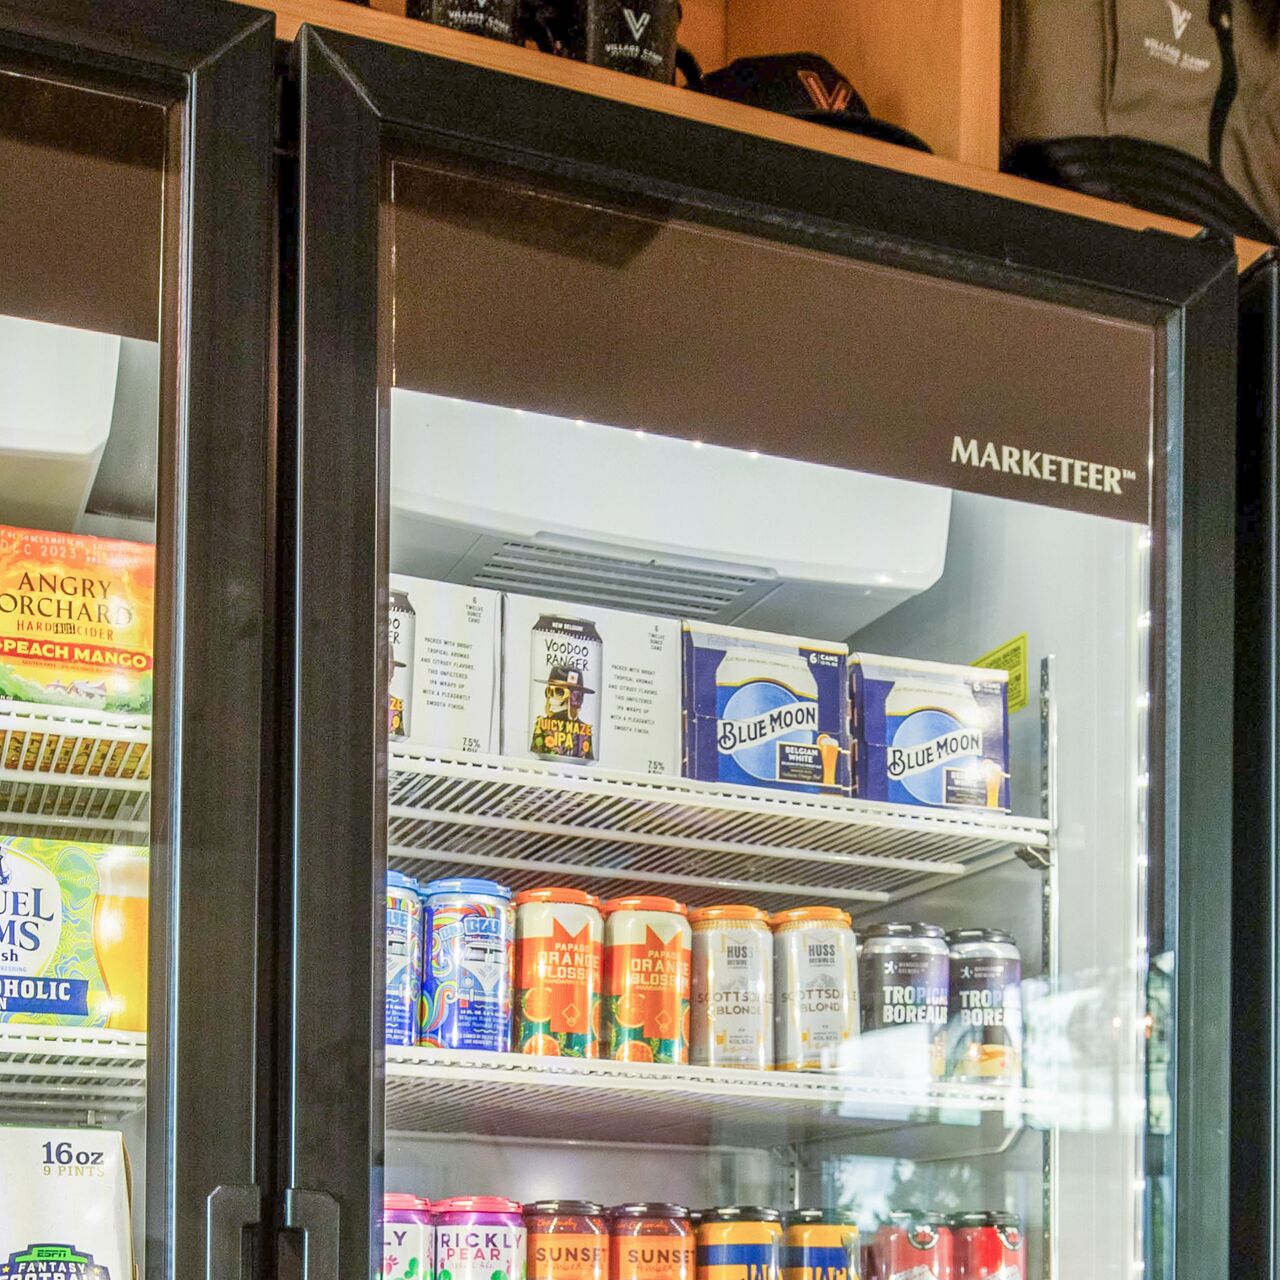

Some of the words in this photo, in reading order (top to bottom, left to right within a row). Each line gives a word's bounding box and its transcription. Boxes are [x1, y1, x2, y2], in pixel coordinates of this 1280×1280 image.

[19, 572, 112, 600] ANGRY
[4, 639, 70, 659] PEACH
[74, 648, 147, 669] MANGO
[545, 639, 589, 657] VOODOO
[546, 654, 589, 672] RANGER
[809, 652, 817, 665] 6
[820, 654, 838, 663] CANS
[536, 716, 564, 733] JUICY
[567, 721, 593, 736] HAZE
[718, 718, 768, 751] BLUE
[770, 704, 817, 734] MOON
[555, 733, 574, 748] IPA
[784, 746, 819, 757] BELGIAN
[788, 753, 813, 763] WHITE
[888, 747, 936, 776] BLUE
[936, 732, 981, 758] MOON
[537, 952, 599, 967] ORANGE
[42, 1142, 72, 1165] 16
[74, 1150, 104, 1165] oz
[43, 1166, 51, 1177] 9
[57, 1166, 105, 1177] PINTS
[37, 1250, 67, 1258] ESPN
[446, 1248, 500, 1261] PEAR
[18, 1262, 86, 1274] FANTASY
